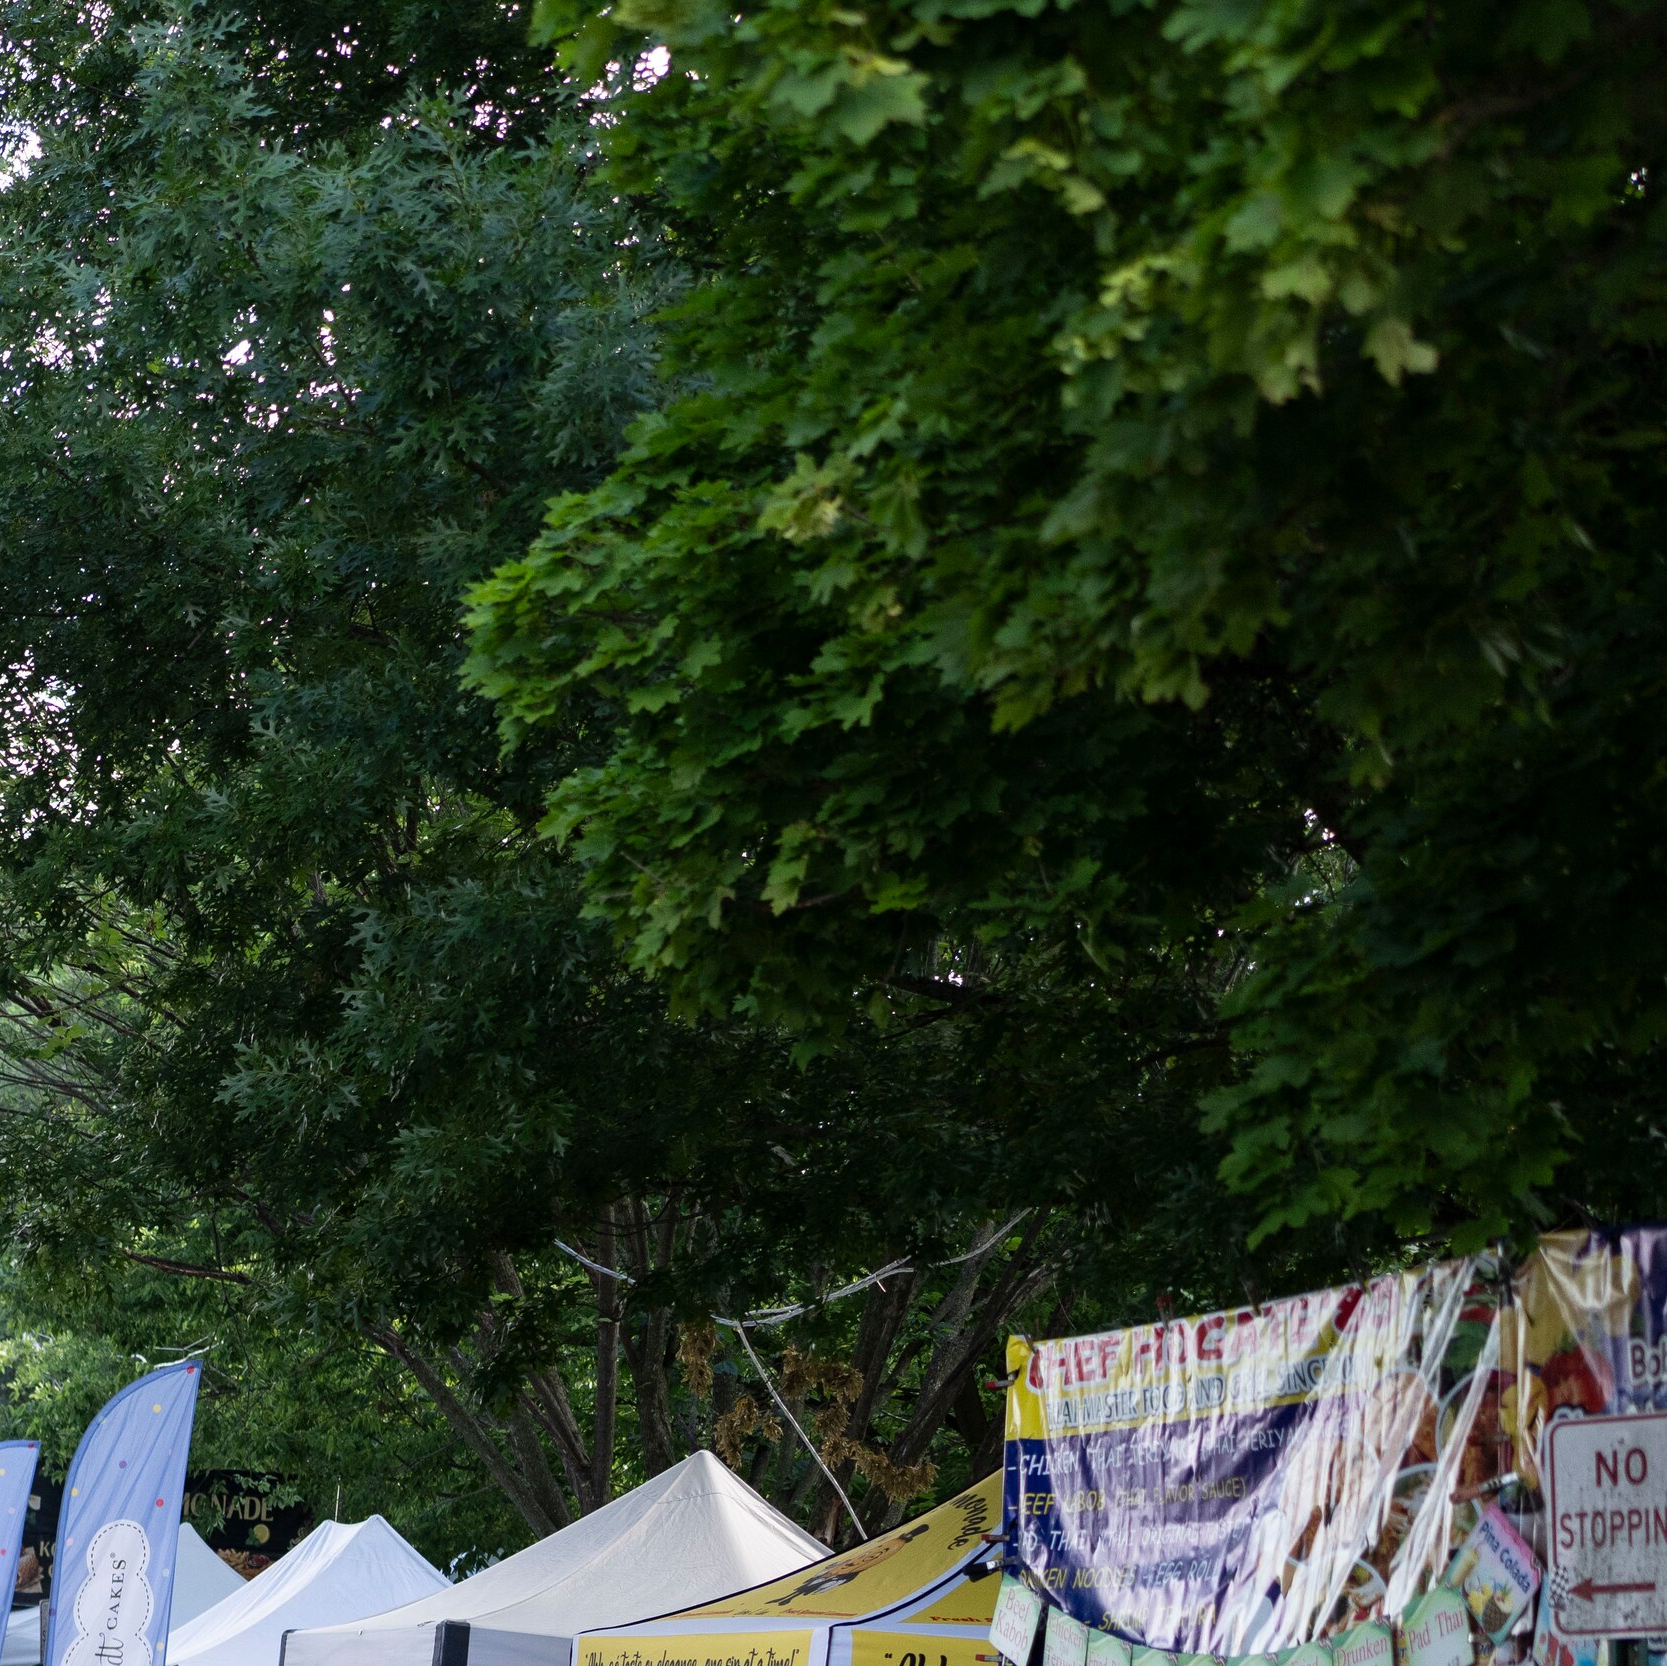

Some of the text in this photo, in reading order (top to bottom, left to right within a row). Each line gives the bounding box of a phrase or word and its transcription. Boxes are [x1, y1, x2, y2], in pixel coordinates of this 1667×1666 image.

[1595, 1448, 1648, 1488] NO
[1201, 1477, 1248, 1499] SAUCE)
[1498, 1549, 1531, 1595] Colada
[1005, 1587, 1034, 1624] Beef
[995, 1614, 1029, 1652] Kabob
[1407, 1607, 1465, 1654] Pad Thai
